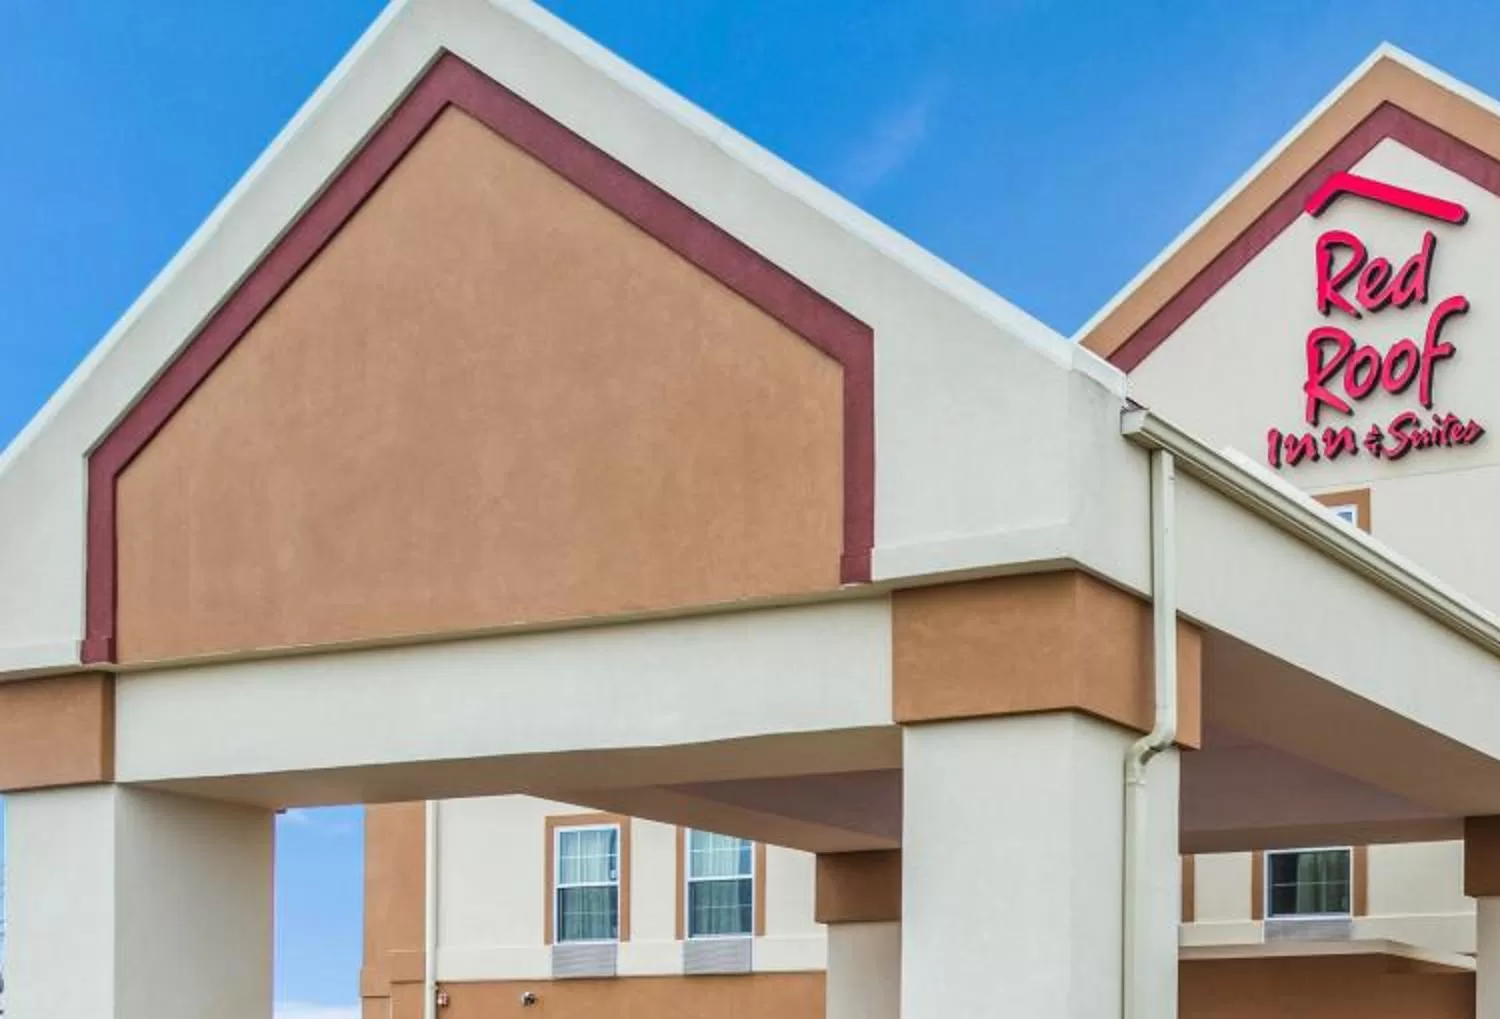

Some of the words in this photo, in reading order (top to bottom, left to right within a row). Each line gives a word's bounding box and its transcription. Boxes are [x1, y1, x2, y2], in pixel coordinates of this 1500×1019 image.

[1316, 231, 1436, 319] Red
[1304, 295, 1470, 427] Roof
[1267, 427, 1358, 469] Inn
[1382, 411, 1486, 461] Suites
